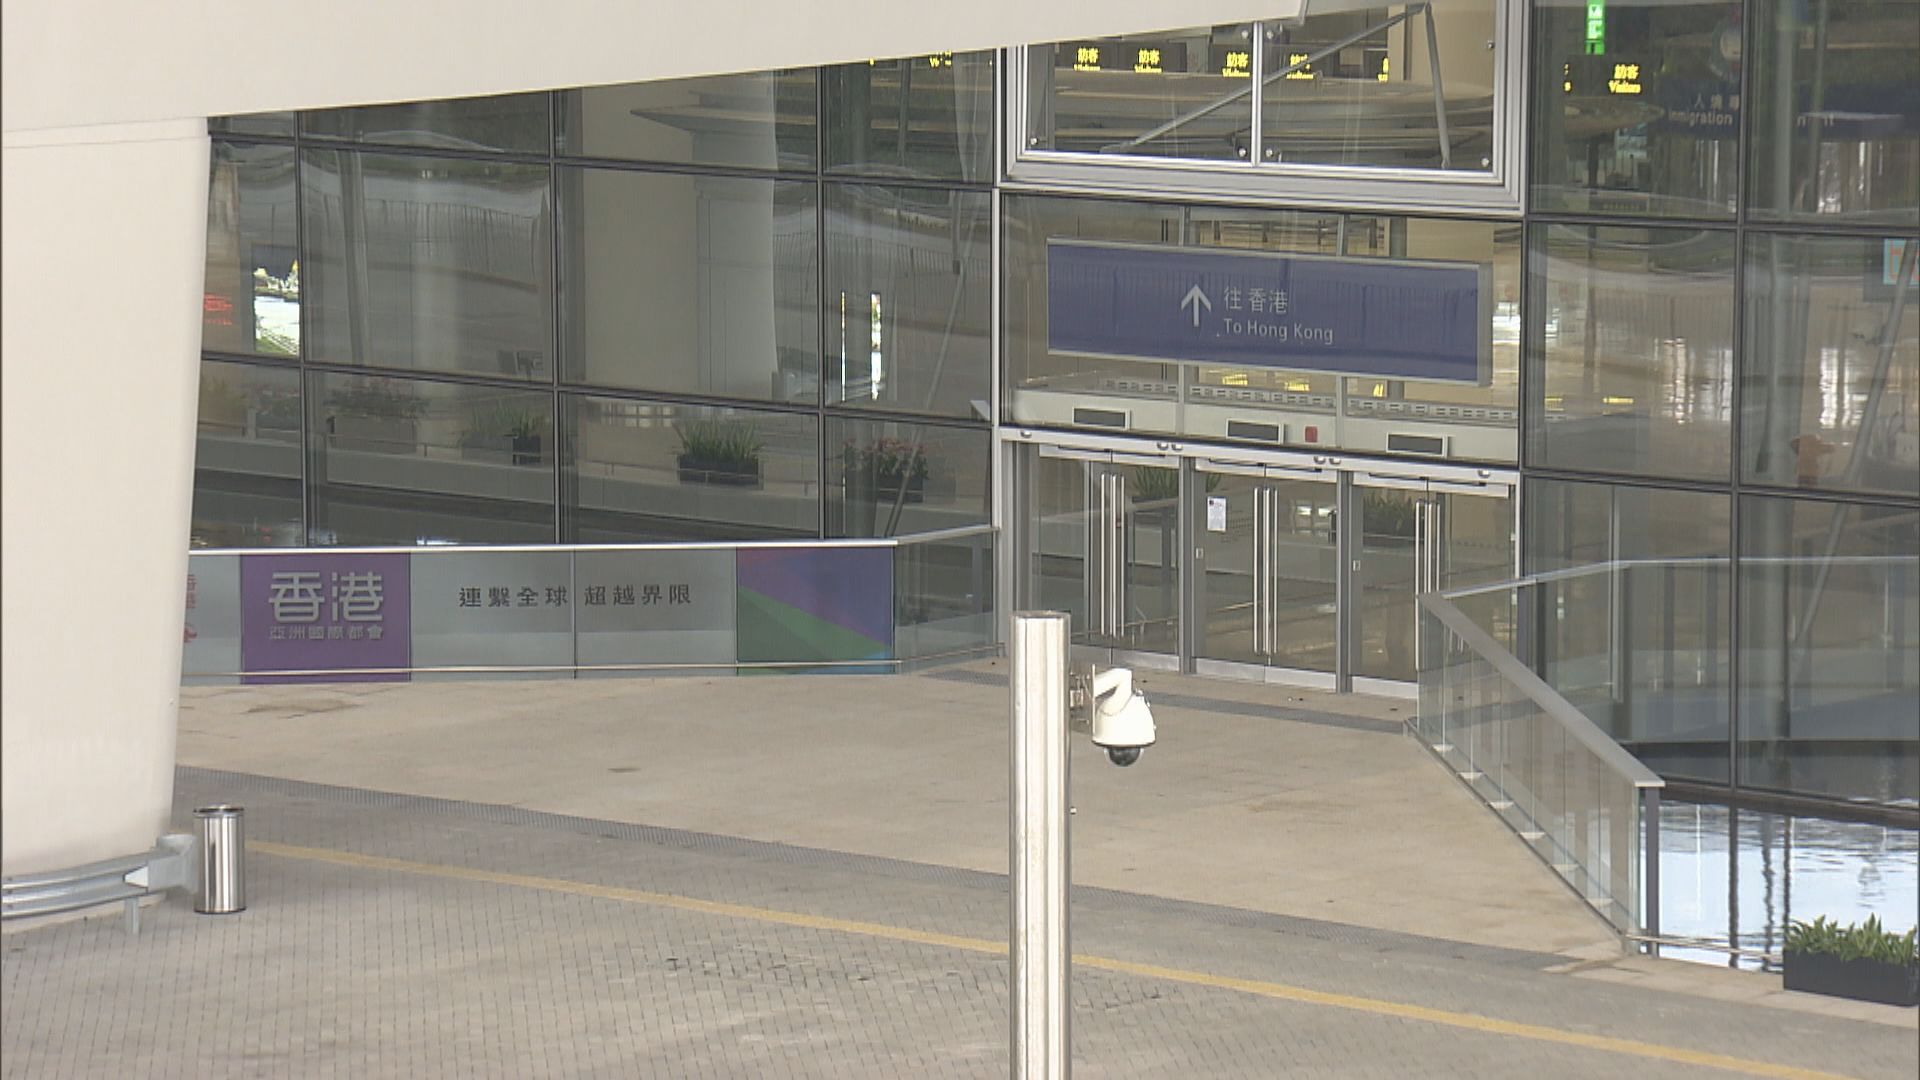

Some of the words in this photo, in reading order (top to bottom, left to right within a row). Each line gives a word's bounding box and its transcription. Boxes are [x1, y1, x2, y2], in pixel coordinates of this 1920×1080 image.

[1223, 287, 1288, 314] 往香港
[1223, 318, 1242, 334] To
[1247, 320, 1288, 342] Hong
[1294, 323, 1333, 345] Kong
[268, 572, 384, 622] 香港
[584, 584, 691, 606] 超越界限
[269, 625, 384, 640] 亞洲國際都會
